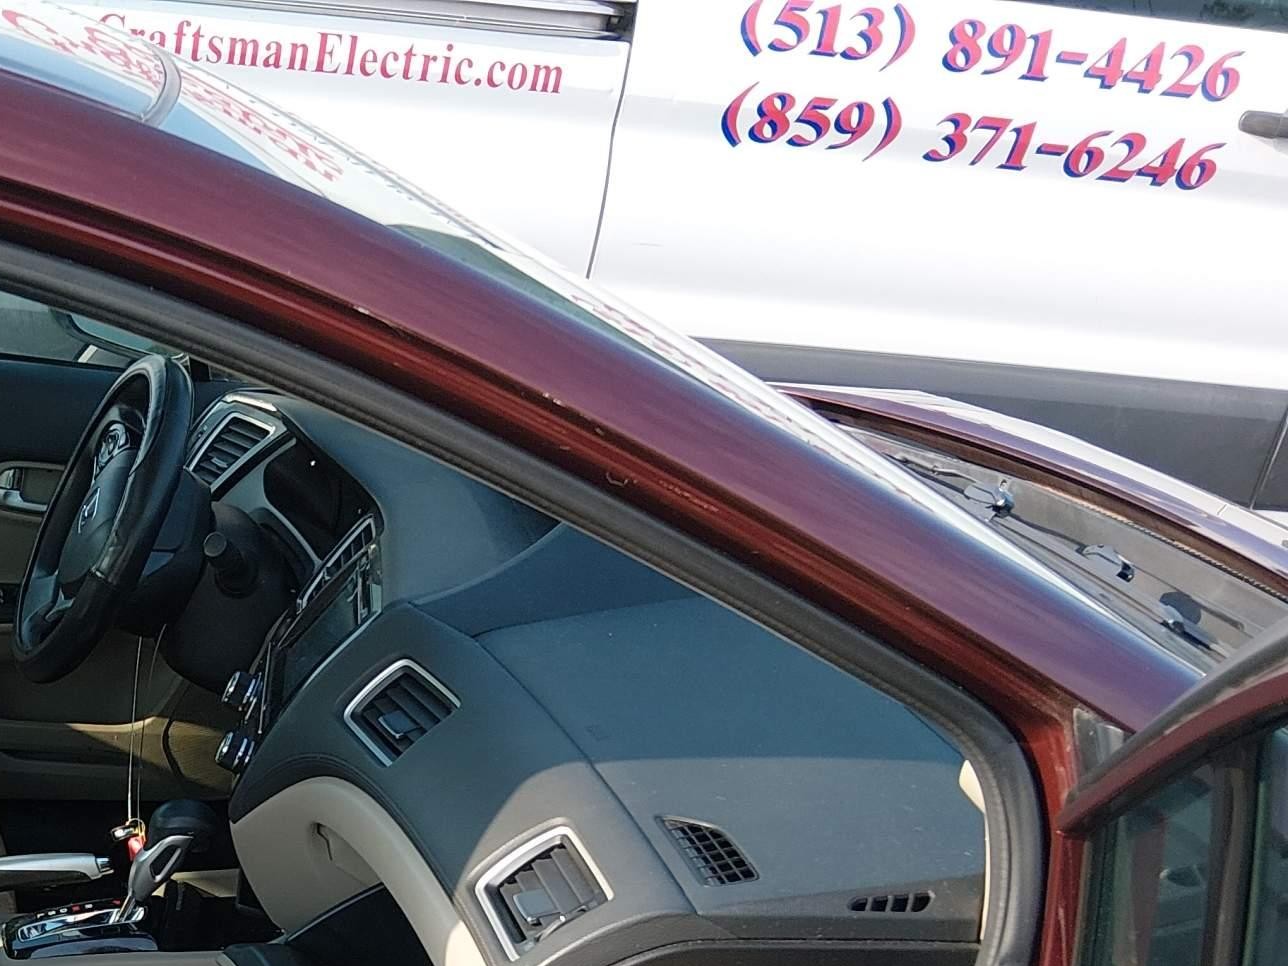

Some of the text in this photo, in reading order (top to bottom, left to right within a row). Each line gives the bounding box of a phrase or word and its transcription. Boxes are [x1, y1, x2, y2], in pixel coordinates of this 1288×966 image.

[740, 0, 1246, 102] (513) 891-4426
[720, 82, 1228, 190] (859) 371-6246
